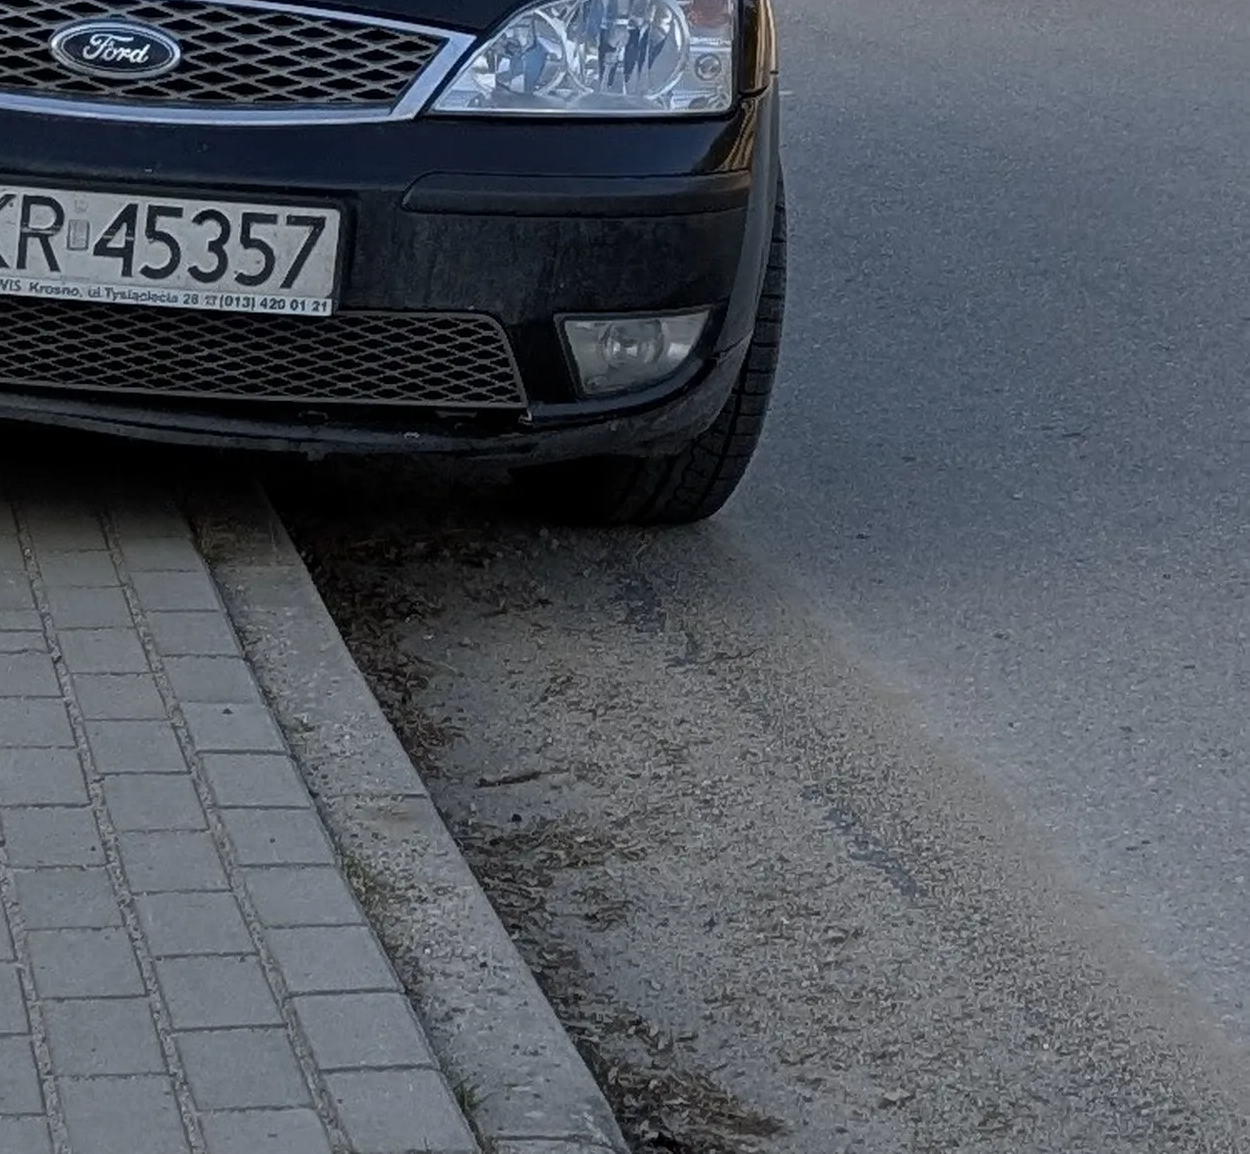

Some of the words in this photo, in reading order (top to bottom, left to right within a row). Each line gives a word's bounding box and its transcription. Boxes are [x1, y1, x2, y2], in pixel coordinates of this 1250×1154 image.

[83, 33, 150, 63] Ford
[92, 202, 327, 290] 45357
[29, 281, 83, 297] Krosno,
[219, 295, 256, 311] (013)
[259, 297, 286, 310] 420
[289, 298, 306, 311] 01
